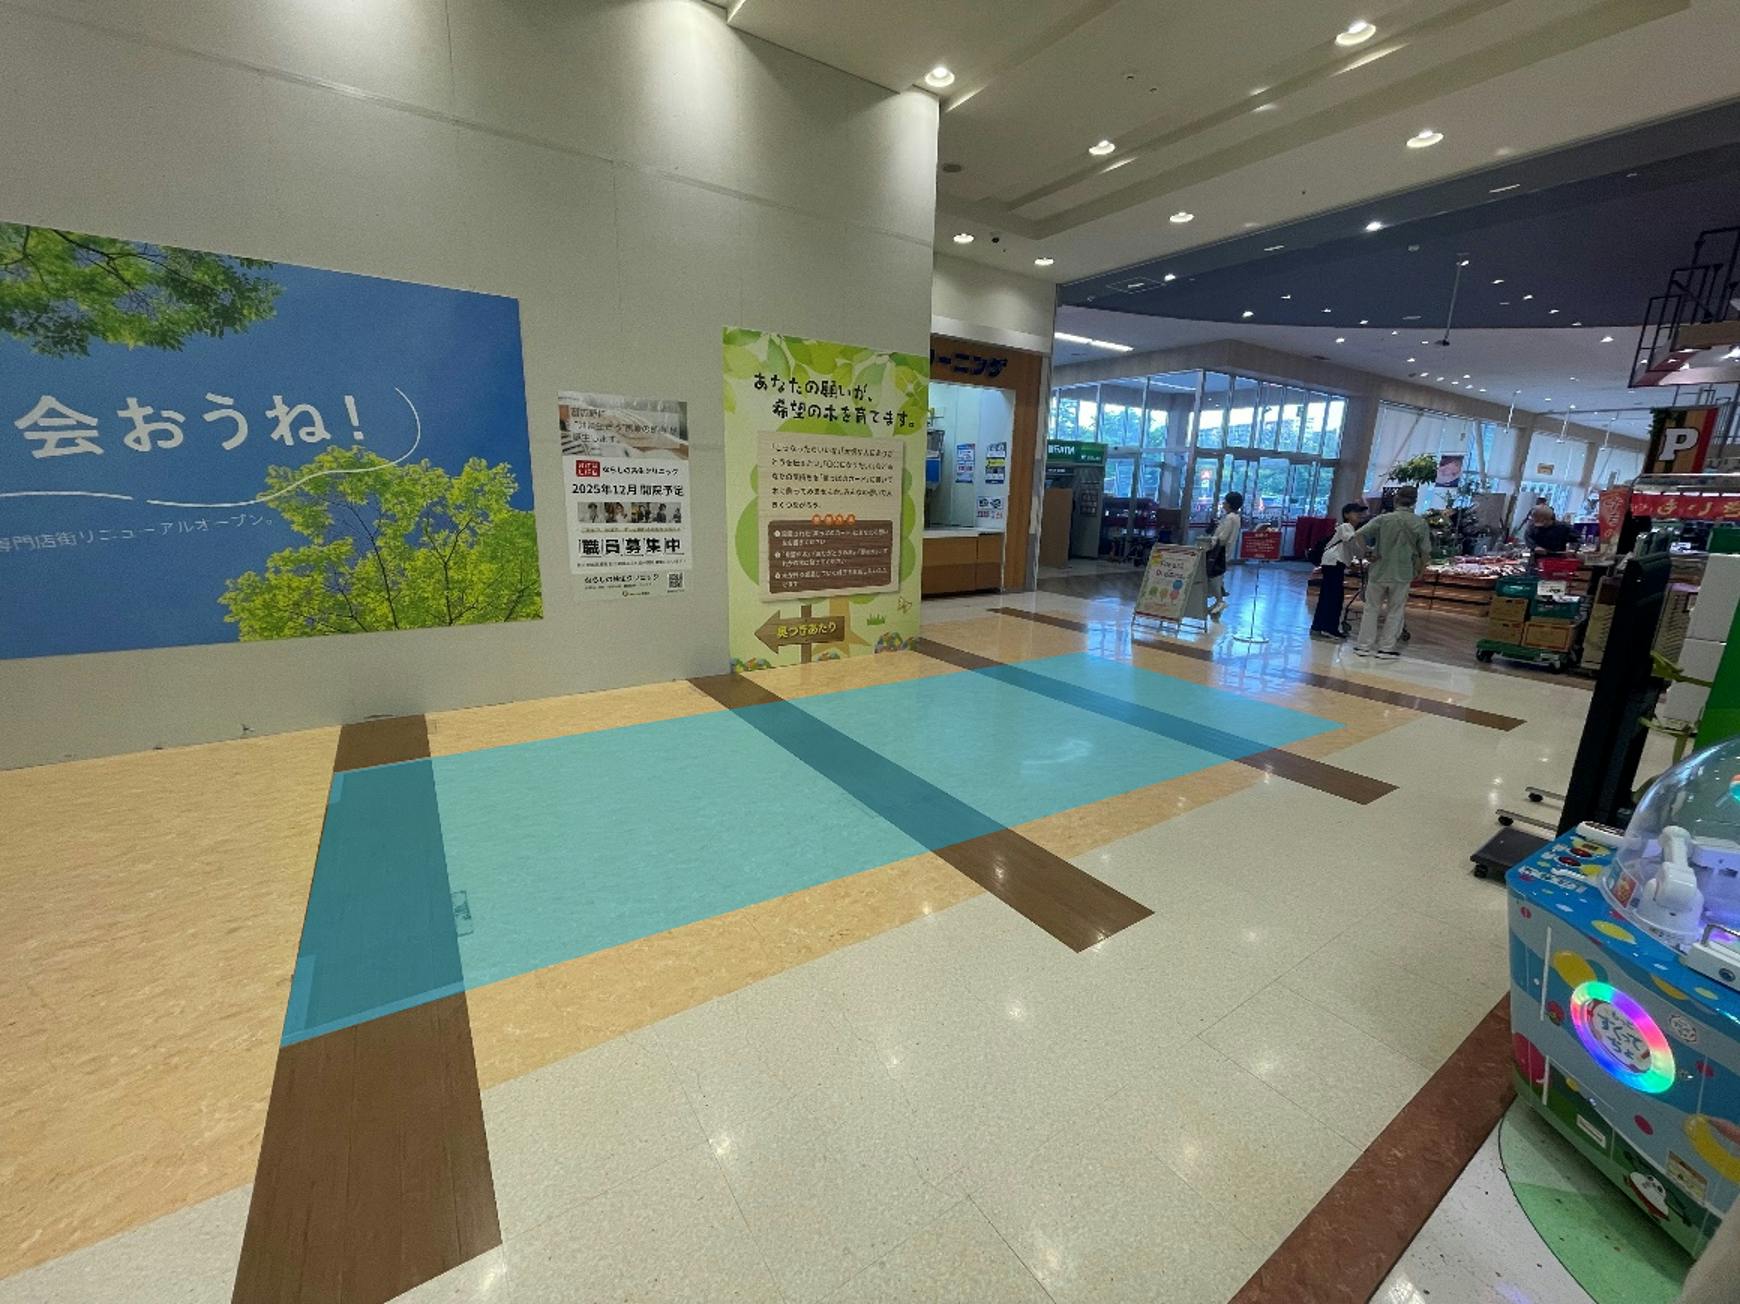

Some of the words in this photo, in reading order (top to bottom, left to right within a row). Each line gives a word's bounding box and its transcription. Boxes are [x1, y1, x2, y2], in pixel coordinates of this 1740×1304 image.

[754, 373, 873, 403] あなたの願いが、
[14, 392, 365, 459] 会おうね！
[773, 399, 915, 429] 希望の木を育てます。
[1658, 427, 1699, 461] P
[572, 483, 637, 496] 2025年12月
[581, 537, 682, 555] 職員募集中
